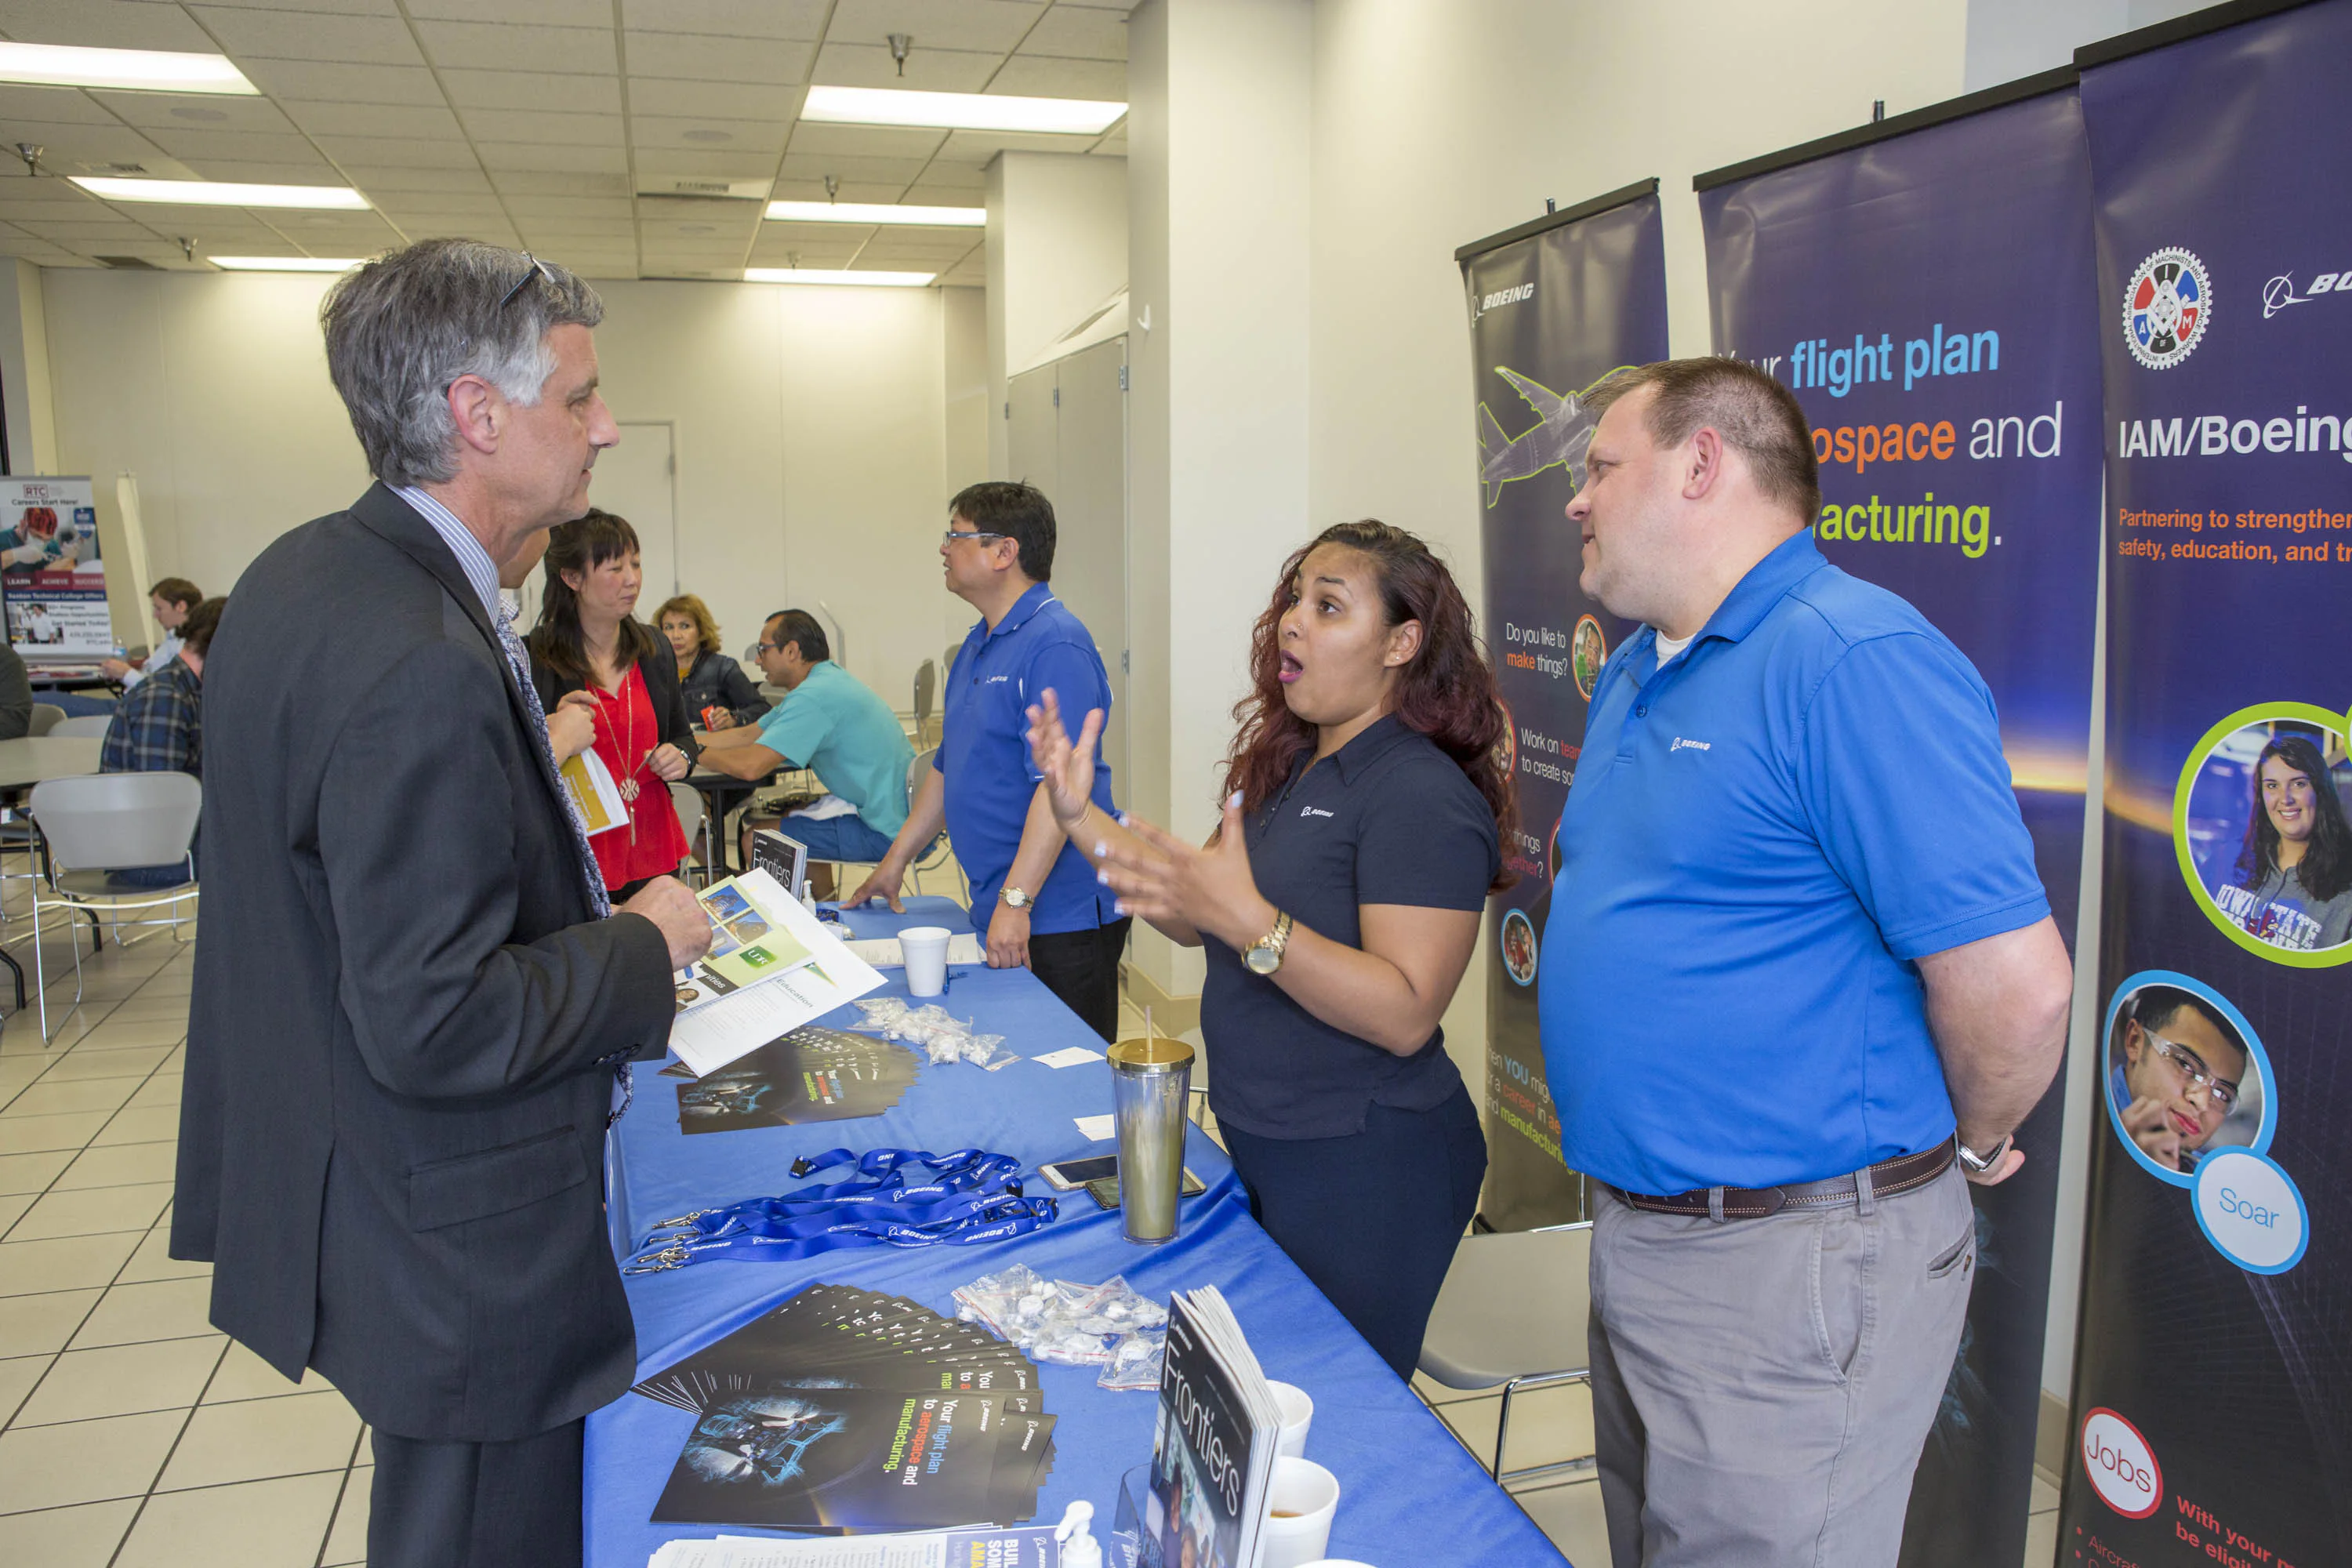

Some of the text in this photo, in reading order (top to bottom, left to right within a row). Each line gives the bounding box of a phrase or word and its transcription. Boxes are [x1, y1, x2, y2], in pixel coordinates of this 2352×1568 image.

[2156, 255, 2191, 267] MACHINISTS
[2190, 266, 2201, 279] AND
[1482, 282, 1534, 310] BOEING
[2128, 270, 2146, 320] ASSOCIATION
[2197, 281, 2207, 328] AEROSPACE
[1791, 334, 1893, 397] flight
[1904, 323, 1999, 391] plan
[2170, 332, 2196, 360] WORKERS
[1811, 401, 2063, 474] ospace and
[26, 487, 45, 497] RTC
[1813, 492, 2002, 558] acturing.
[2119, 508, 2202, 532] Partnering
[2209, 510, 2229, 528] to
[2118, 539, 2166, 561] safety,
[2171, 539, 2278, 564] education,
[2285, 542, 2328, 561] and
[1506, 622, 1566, 648] Do you like to
[1507, 652, 1567, 679] make things?
[1521, 728, 1546, 750] Work
[1548, 739, 1559, 754] on
[1681, 739, 1711, 751] BOEING
[1522, 754, 1574, 786] to create so
[776, 978, 814, 1008] Education
[1504, 1054, 1529, 1085] YOU
[1531, 1076, 1554, 1104] mig
[1495, 1079, 1501, 1092] a
[1503, 1084, 1536, 1116] career
[1537, 1103, 1546, 1123] in
[1548, 1116, 1562, 1135] ae
[2220, 1187, 2280, 1229] Soar
[900, 1229, 938, 1240] BOEING
[964, 1229, 1005, 1243] BOEING
[960, 1372, 974, 1381] to
[979, 1371, 993, 1388] You
[981, 1408, 990, 1432] BOEING
[1163, 1339, 1240, 1517] Frontiers
[883, 1399, 916, 1473] manufacturing.
[902, 1399, 938, 1486] to aerospace and
[926, 1399, 959, 1474] Your flight plan
[1022, 1428, 1035, 1451] BOEING
[2087, 1434, 2151, 1493] Jobs
[2176, 1495, 2272, 1563] With your
[2176, 1521, 2252, 1568] be eligi
